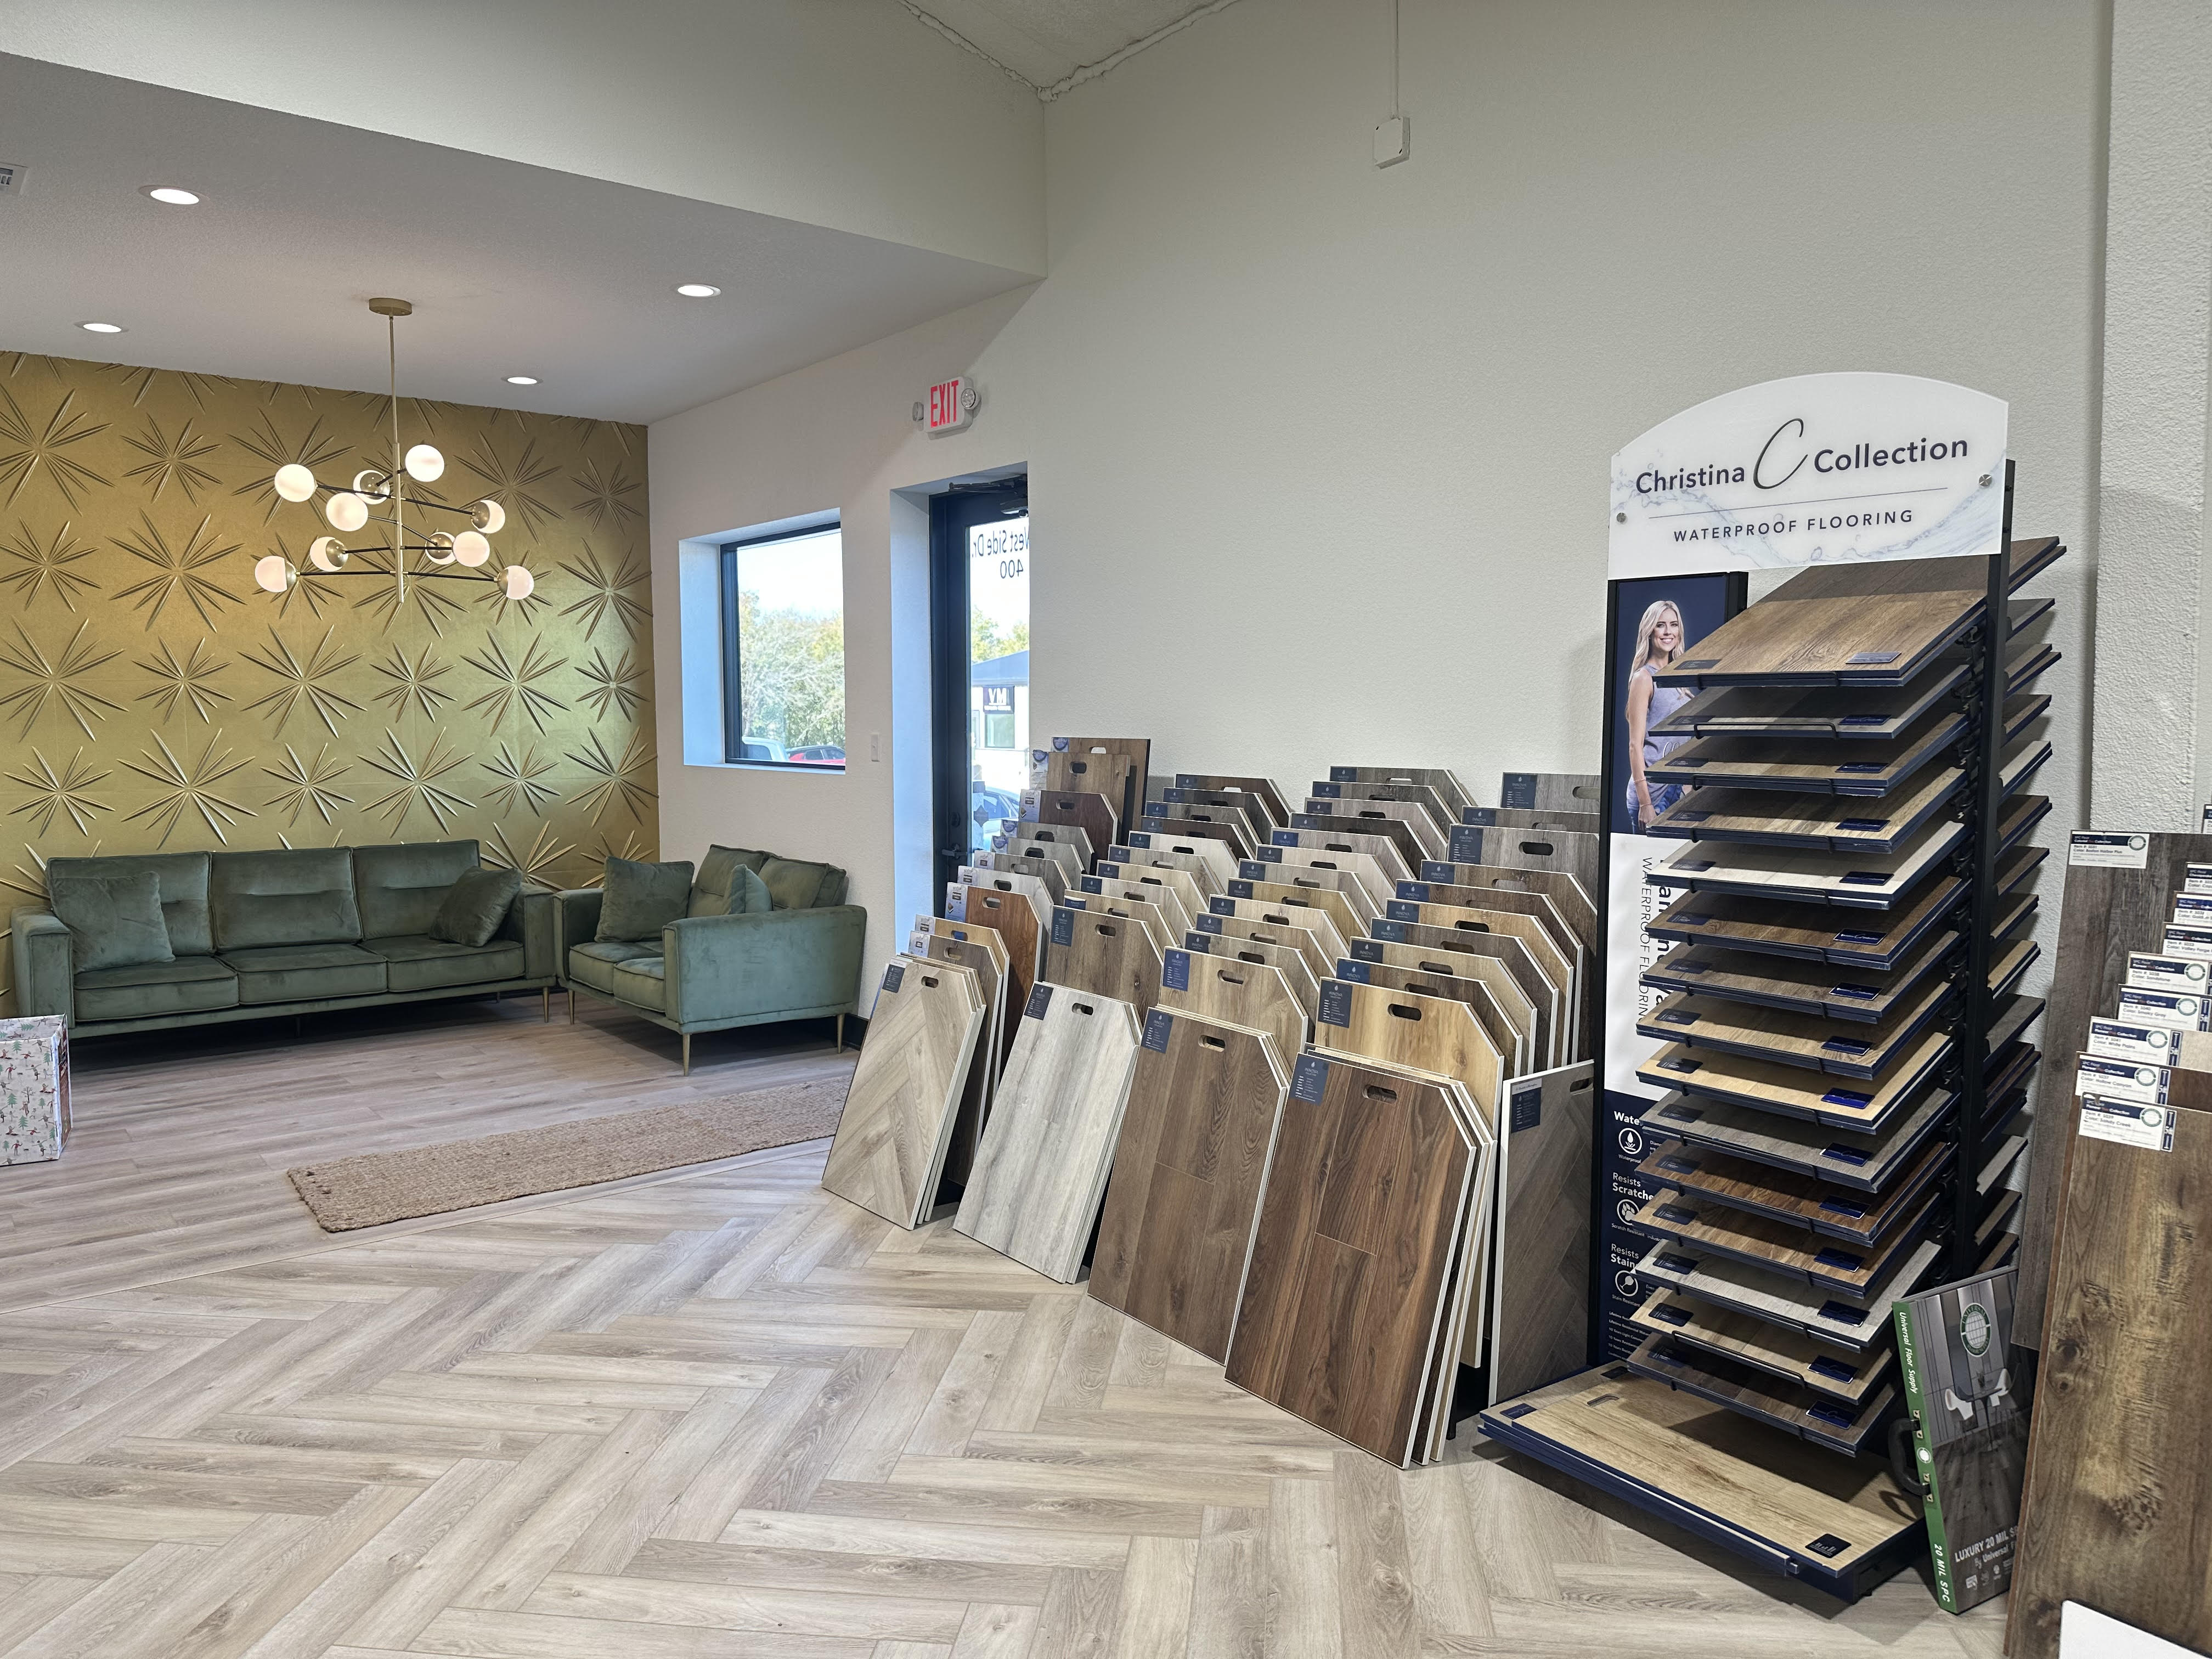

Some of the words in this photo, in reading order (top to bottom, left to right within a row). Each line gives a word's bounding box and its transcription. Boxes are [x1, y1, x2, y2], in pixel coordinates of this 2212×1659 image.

[930, 380, 959, 427] EXIT
[1636, 464, 1745, 494] Christina
[1753, 417, 1808, 489] C
[1814, 437, 1968, 473] Collection
[1674, 520, 1797, 542] WATERPROOF
[1808, 509, 1912, 531] FLOORING
[1638, 957, 1649, 1021] FLORIN
[1614, 1110, 1641, 1126] Wate
[1618, 1154, 1641, 1164] Waterproof
[1613, 1172, 1641, 1187] Resists
[1611, 1223, 1626, 1231] Scratch
[1611, 1243, 1639, 1259] Resists
[1611, 1254, 1638, 1269] Stain
[1899, 1312, 1911, 1346] Universal
[1905, 1347, 1913, 1367] Floor
[1908, 1369, 1918, 1393] Supply
[1934, 1544, 1943, 1556] 20
[1954, 1541, 1984, 1563] LUXURY
[1986, 1536, 1995, 1549] 20
[1995, 1530, 2008, 1545] MIL
[1982, 1544, 2009, 1562] Universal
[1937, 1559, 1946, 1576] MIL
[1940, 1581, 1950, 1602] SPC
